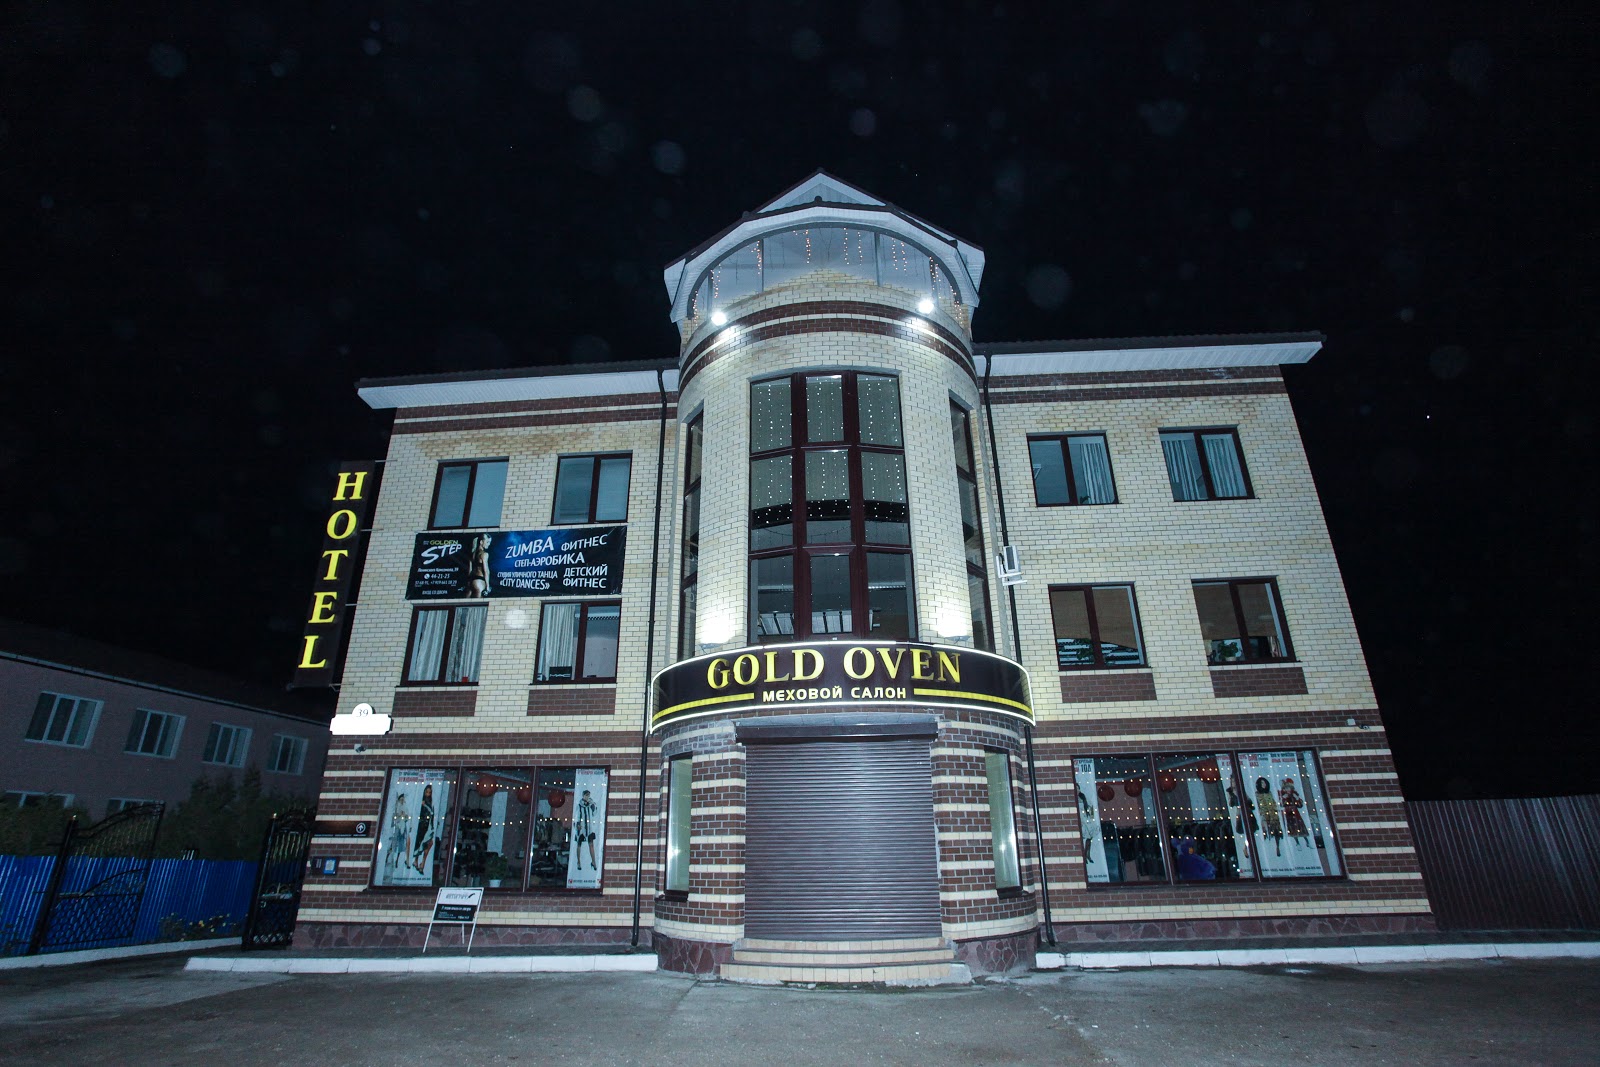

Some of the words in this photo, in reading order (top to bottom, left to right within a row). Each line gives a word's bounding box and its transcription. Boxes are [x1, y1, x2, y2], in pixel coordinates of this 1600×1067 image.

[505, 536, 554, 559] ZUMBA
[561, 534, 608, 551] ФИТНЕС
[421, 544, 462, 565] STEP
[514, 552, 585, 568] СТЕП-АЭРОБИКА
[297, 471, 368, 668] HOTEL
[537, 570, 558, 579] ТАНЦА
[563, 564, 608, 578] ДЕТСКИЙ
[563, 578, 607, 589] ФИТНЕС
[707, 649, 825, 690] GOLD
[843, 646, 961, 684] OVEN
[763, 685, 843, 703] МЕХОВОЙ
[850, 687, 907, 699] САЛОН
